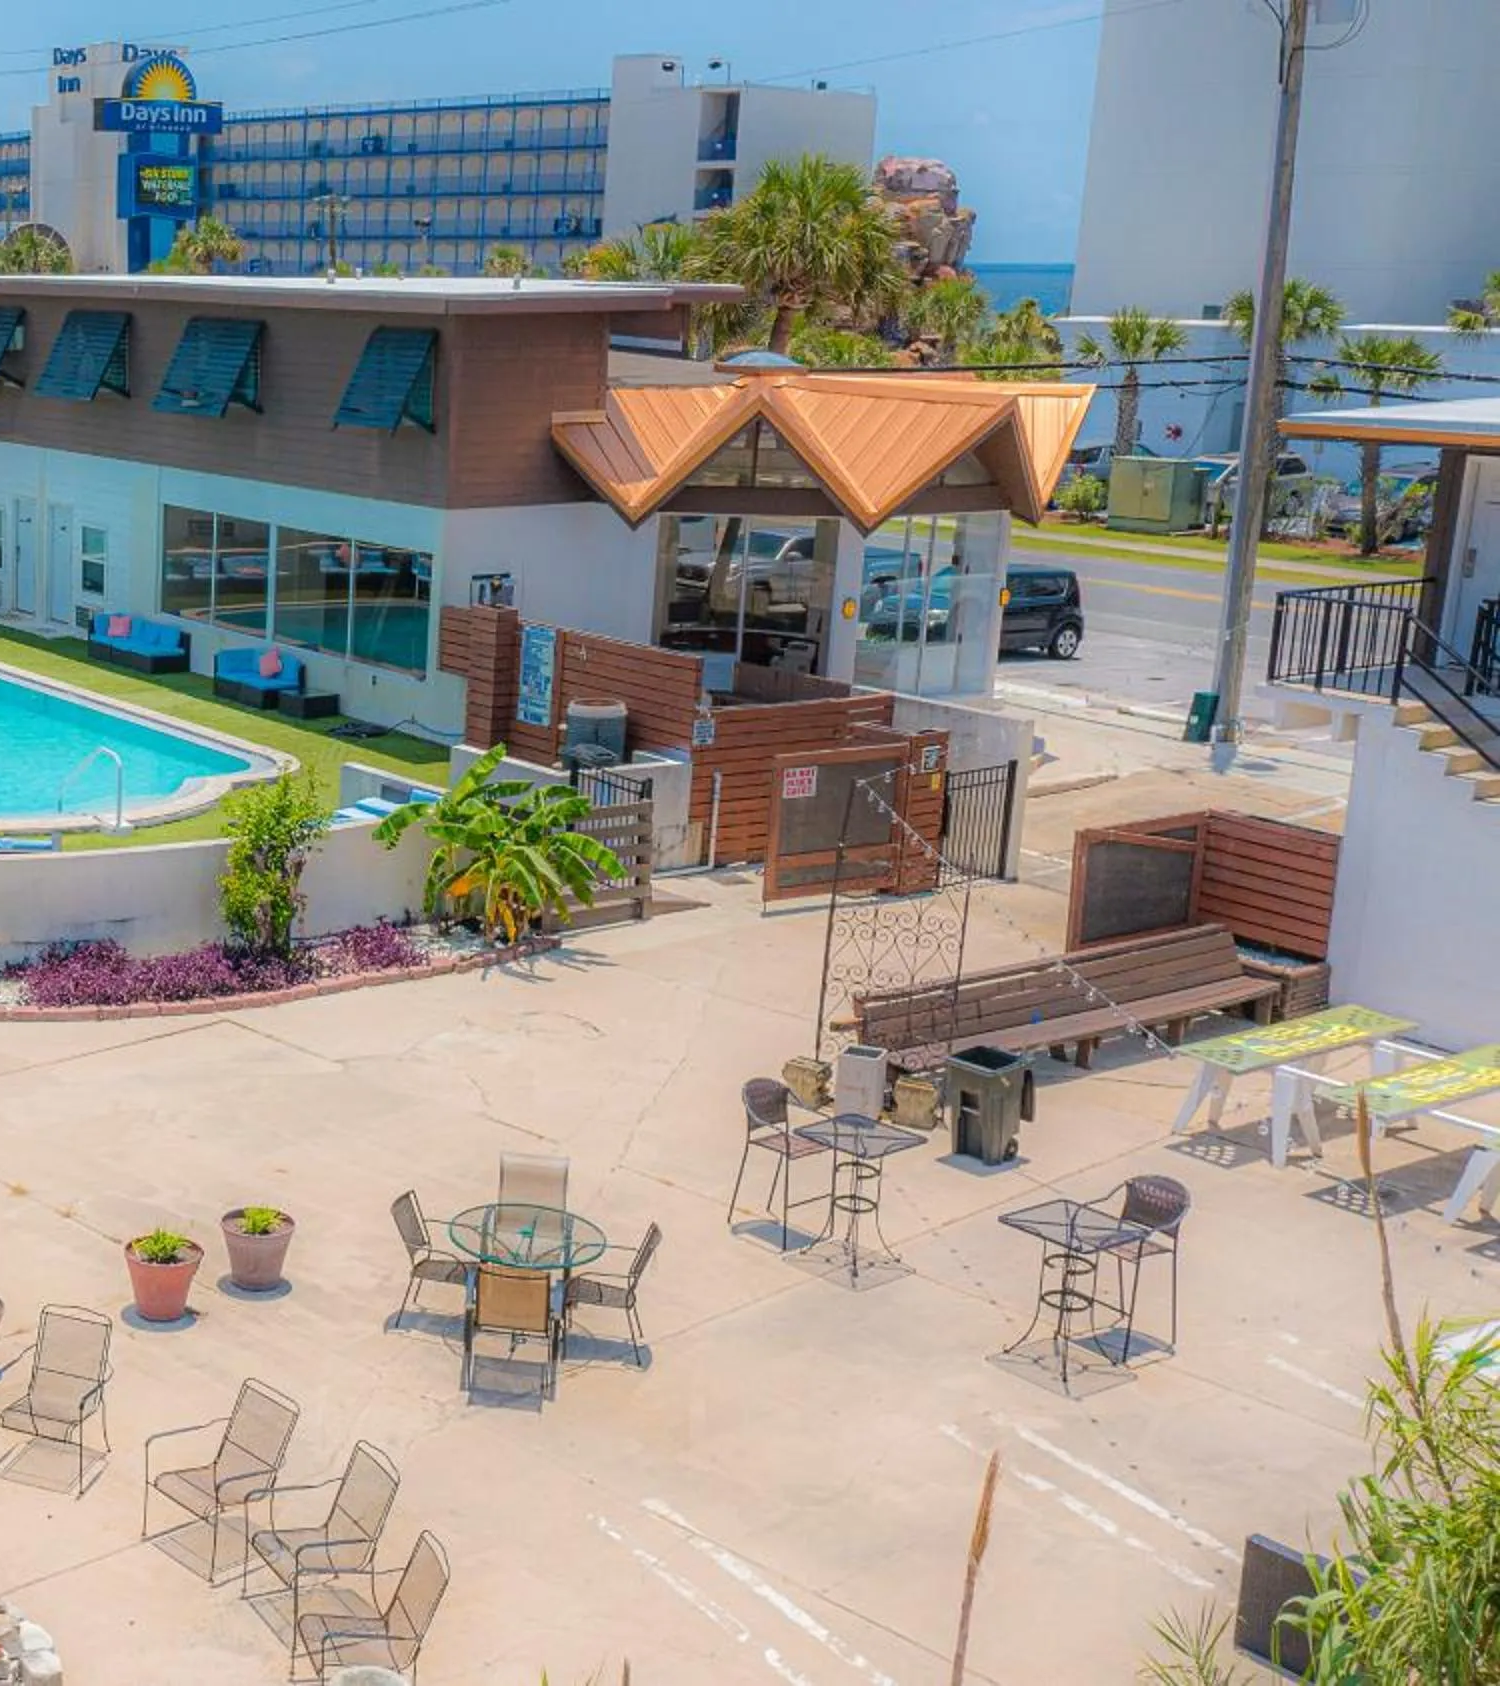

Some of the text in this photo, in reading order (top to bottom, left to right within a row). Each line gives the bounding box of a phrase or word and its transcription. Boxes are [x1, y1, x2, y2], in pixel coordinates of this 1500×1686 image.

[53, 47, 87, 67] Days
[57, 75, 81, 93] Inn
[121, 103, 207, 123] Days Inn
